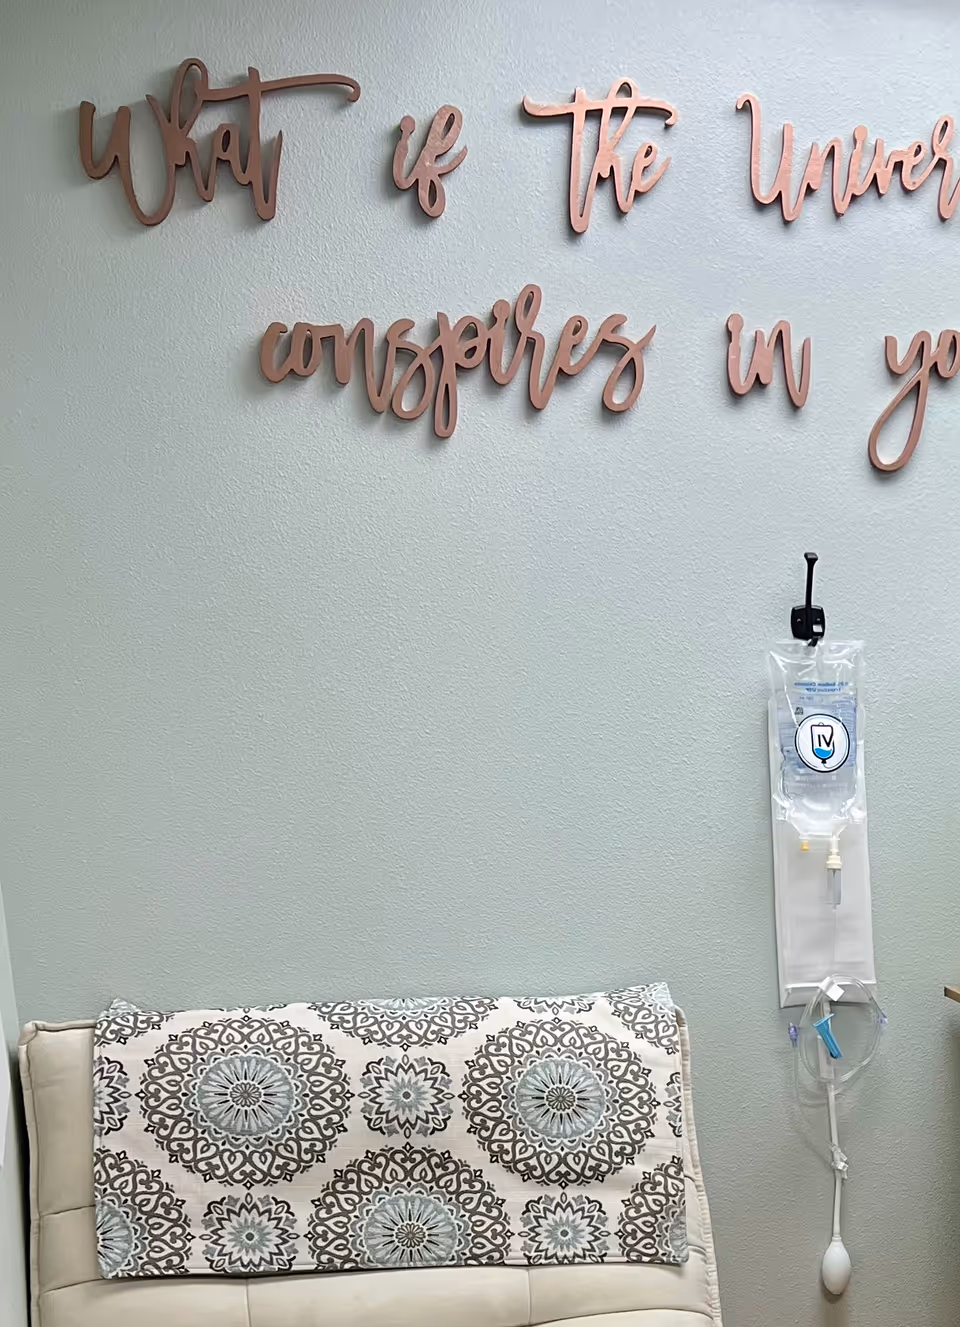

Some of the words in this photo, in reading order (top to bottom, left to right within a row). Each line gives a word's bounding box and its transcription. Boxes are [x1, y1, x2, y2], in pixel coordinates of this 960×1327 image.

[79, 57, 361, 226] What
[391, 103, 469, 218] if
[522, 76, 678, 234] the
[259, 282, 657, 440] conspires
[725, 312, 811, 408] in
[817, 734, 834, 748] IV
